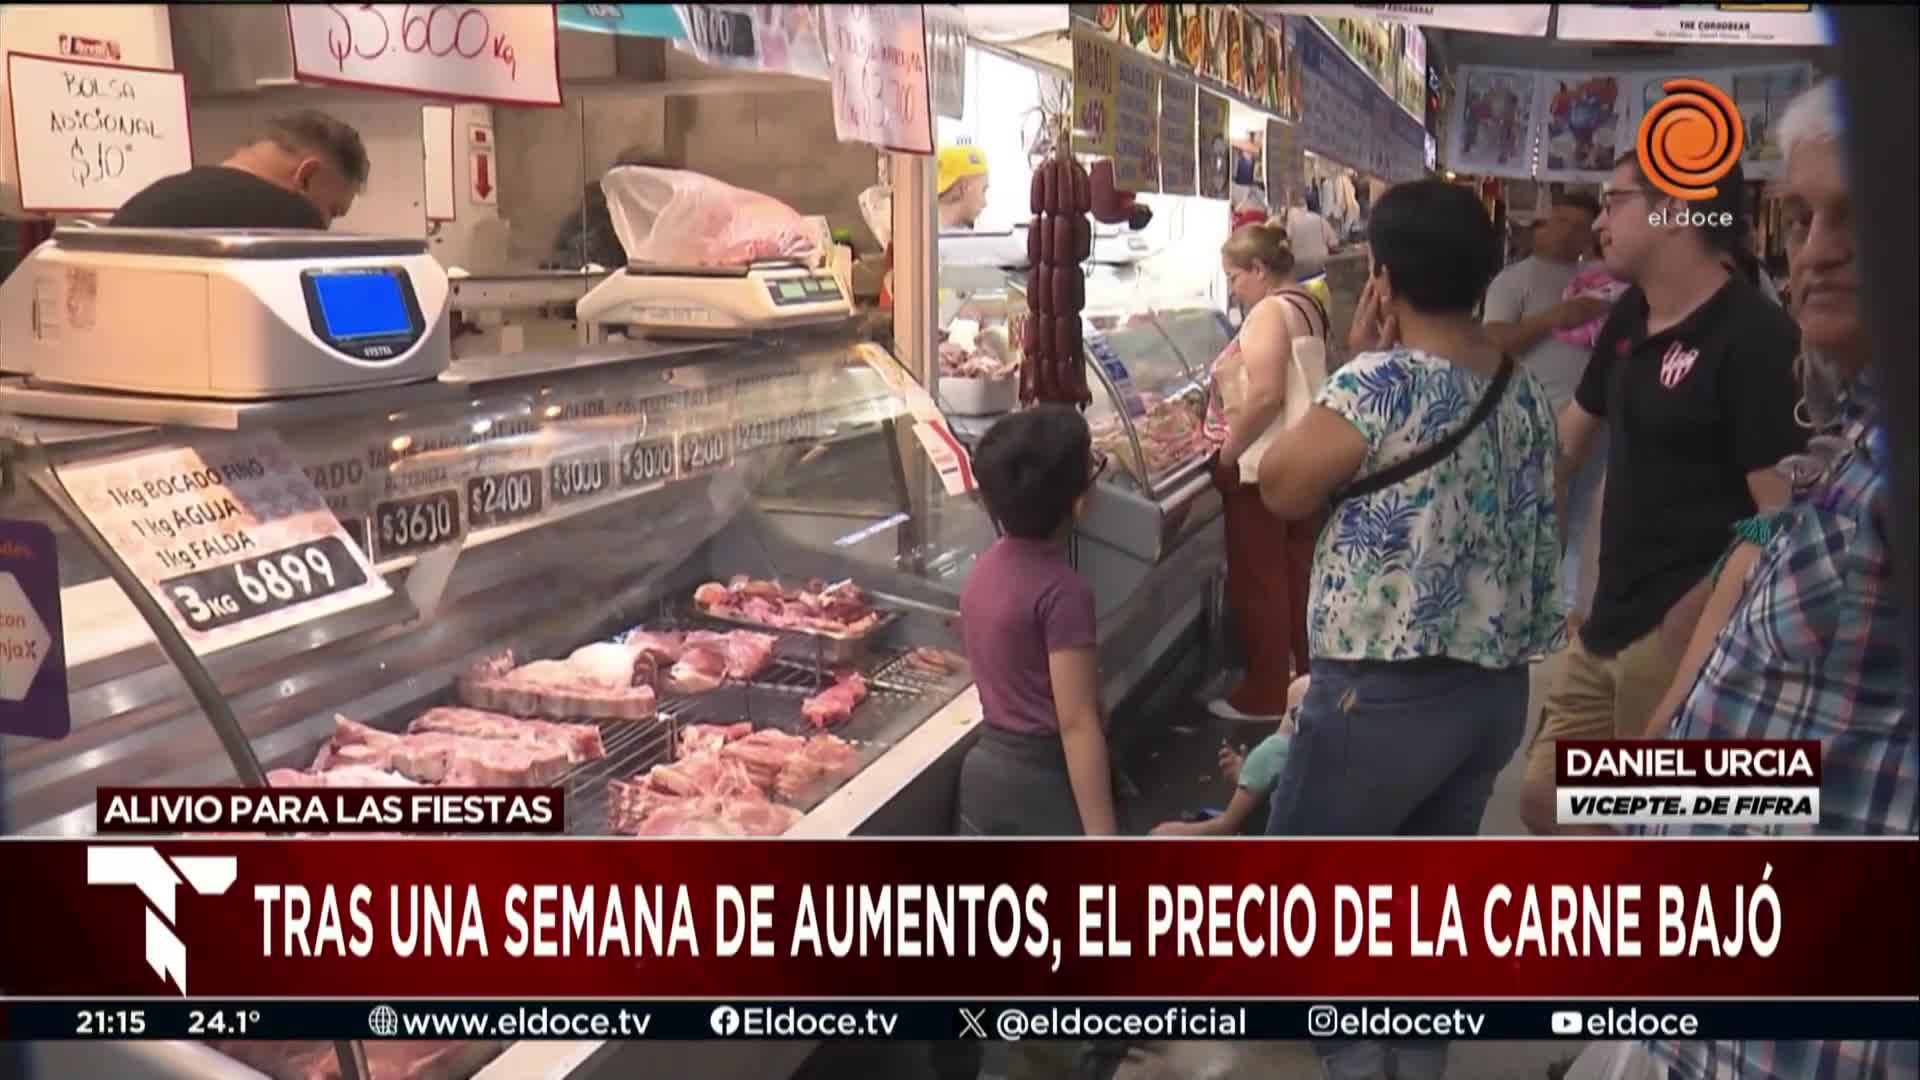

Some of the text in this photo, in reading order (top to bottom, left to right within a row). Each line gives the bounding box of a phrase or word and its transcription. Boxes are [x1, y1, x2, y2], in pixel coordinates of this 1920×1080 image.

[63, 70, 136, 101] BOLSA
[50, 106, 166, 140] ADICIONAL
[107, 458, 264, 508] 1kg BOCADO FINO
[132, 499, 243, 539] 1kg AGUJA
[156, 530, 257, 570] 1kg FALDA
[234, 546, 336, 605] 6899
